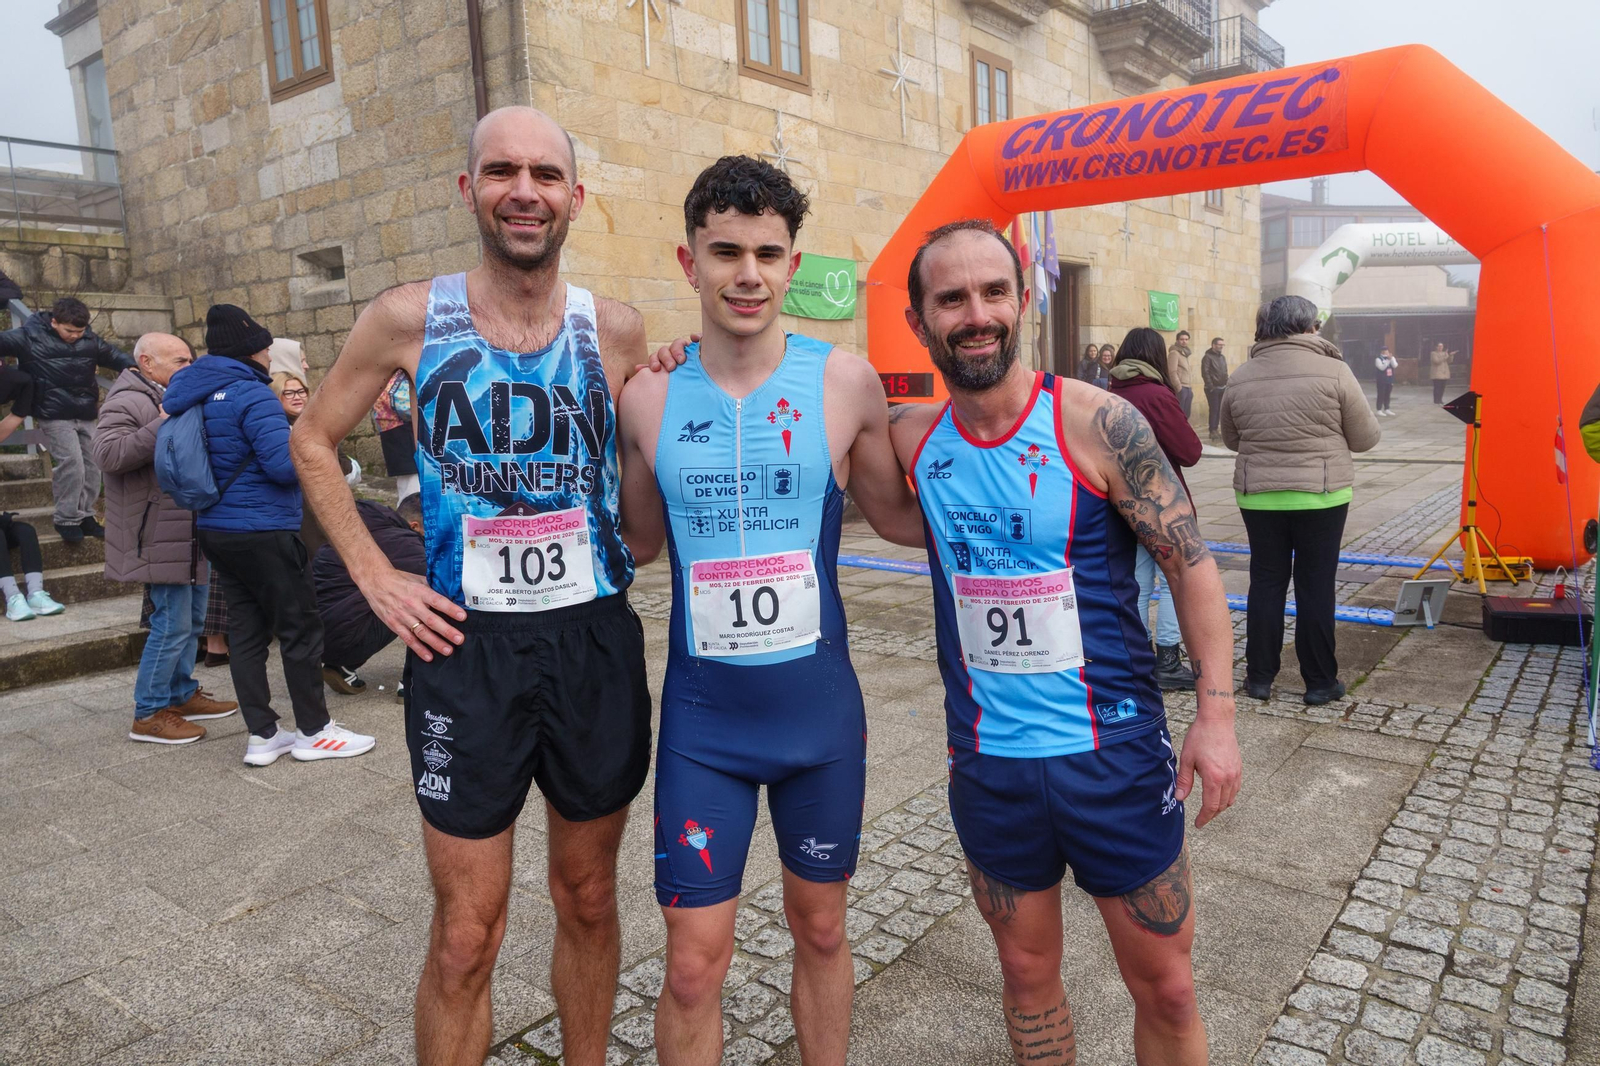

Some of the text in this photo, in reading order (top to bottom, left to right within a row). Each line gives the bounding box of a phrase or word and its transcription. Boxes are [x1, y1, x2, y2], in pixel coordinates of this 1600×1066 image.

[1001, 67, 1341, 160] CRONOTEC
[1002, 125, 1329, 193] WWW.CRONOTEC.ES
[1372, 232, 1426, 247] HOTEL
[1370, 248, 1468, 258] www.hotelrectoral.com
[213, 392, 227, 401] HH
[431, 381, 605, 460] ADN
[677, 434, 710, 443] ZICO
[440, 461, 596, 495] RUNNERS
[686, 471, 757, 485] CONCELLO
[927, 471, 952, 480] ZICO
[694, 484, 749, 498] DE VIGO
[1118, 499, 1137, 510] POR
[717, 506, 768, 520] XUNTA
[946, 510, 998, 523] CONCELLO
[474, 528, 524, 537] CONTRA
[526, 529, 536, 537] O
[537, 520, 580, 534] CANCRO
[493, 514, 563, 529] CORREMOS
[718, 518, 799, 532] DE GALICIA
[954, 524, 993, 535] DE VIGO
[524, 535, 552, 545] FEBREIRO
[561, 531, 575, 539] 2026
[498, 542, 566, 586] 103
[713, 555, 785, 571] CORREMOS
[698, 563, 804, 581] CONTRA O CANCRO
[742, 577, 775, 586] FEBREIRO
[786, 574, 801, 582] 2026
[972, 577, 1043, 589] CORREMOS
[533, 586, 555, 595] BASTOS
[555, 581, 578, 591] DASILVA
[961, 583, 1064, 597] CONTRA O CANCRO
[729, 586, 780, 628] 10
[1000, 598, 1031, 606] FEBREIRO
[1043, 595, 1060, 603] 2026
[736, 629, 772, 639] RODRÍGUEZ
[772, 626, 795, 635] COSTAS
[986, 606, 1033, 648] 91
[1002, 649, 1020, 657] PÉREZ
[418, 770, 451, 794] ADN
[417, 787, 449, 801] RUNNERS
[799, 843, 831, 861] ZICO
